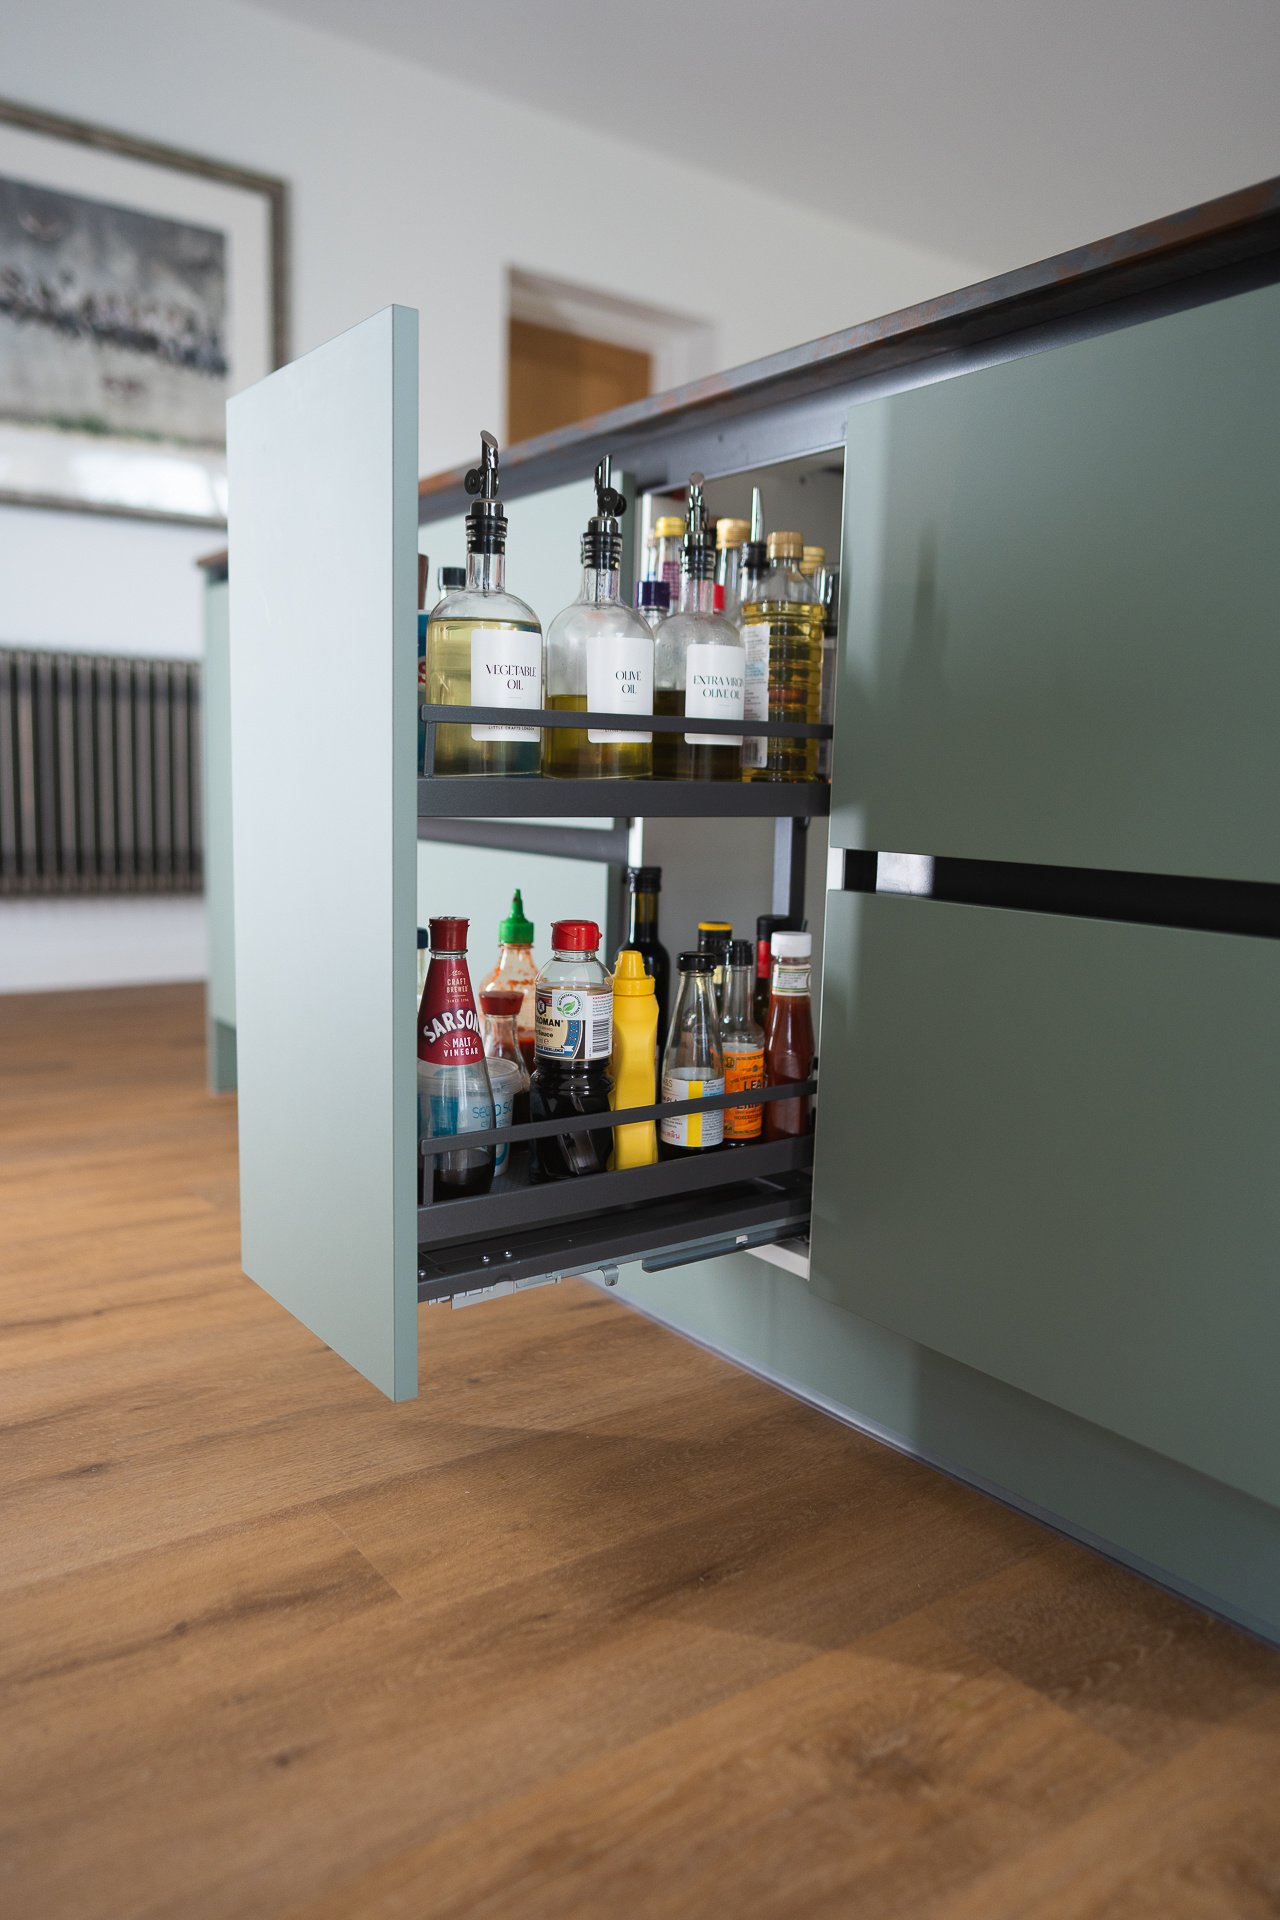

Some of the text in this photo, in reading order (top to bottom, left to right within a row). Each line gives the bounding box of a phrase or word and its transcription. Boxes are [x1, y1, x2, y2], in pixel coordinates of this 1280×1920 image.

[485, 664, 537, 678] VEGETABLE
[615, 670, 642, 681] OLIVE
[507, 679, 523, 690] OIL
[693, 674, 724, 685] EXTRA
[621, 683, 637, 694] OIL
[702, 688, 729, 699] OLIVE
[446, 978, 467, 986] CRAFT
[452, 1036, 471, 1048] MALT
[443, 1047, 479, 1057] VINEGAR
